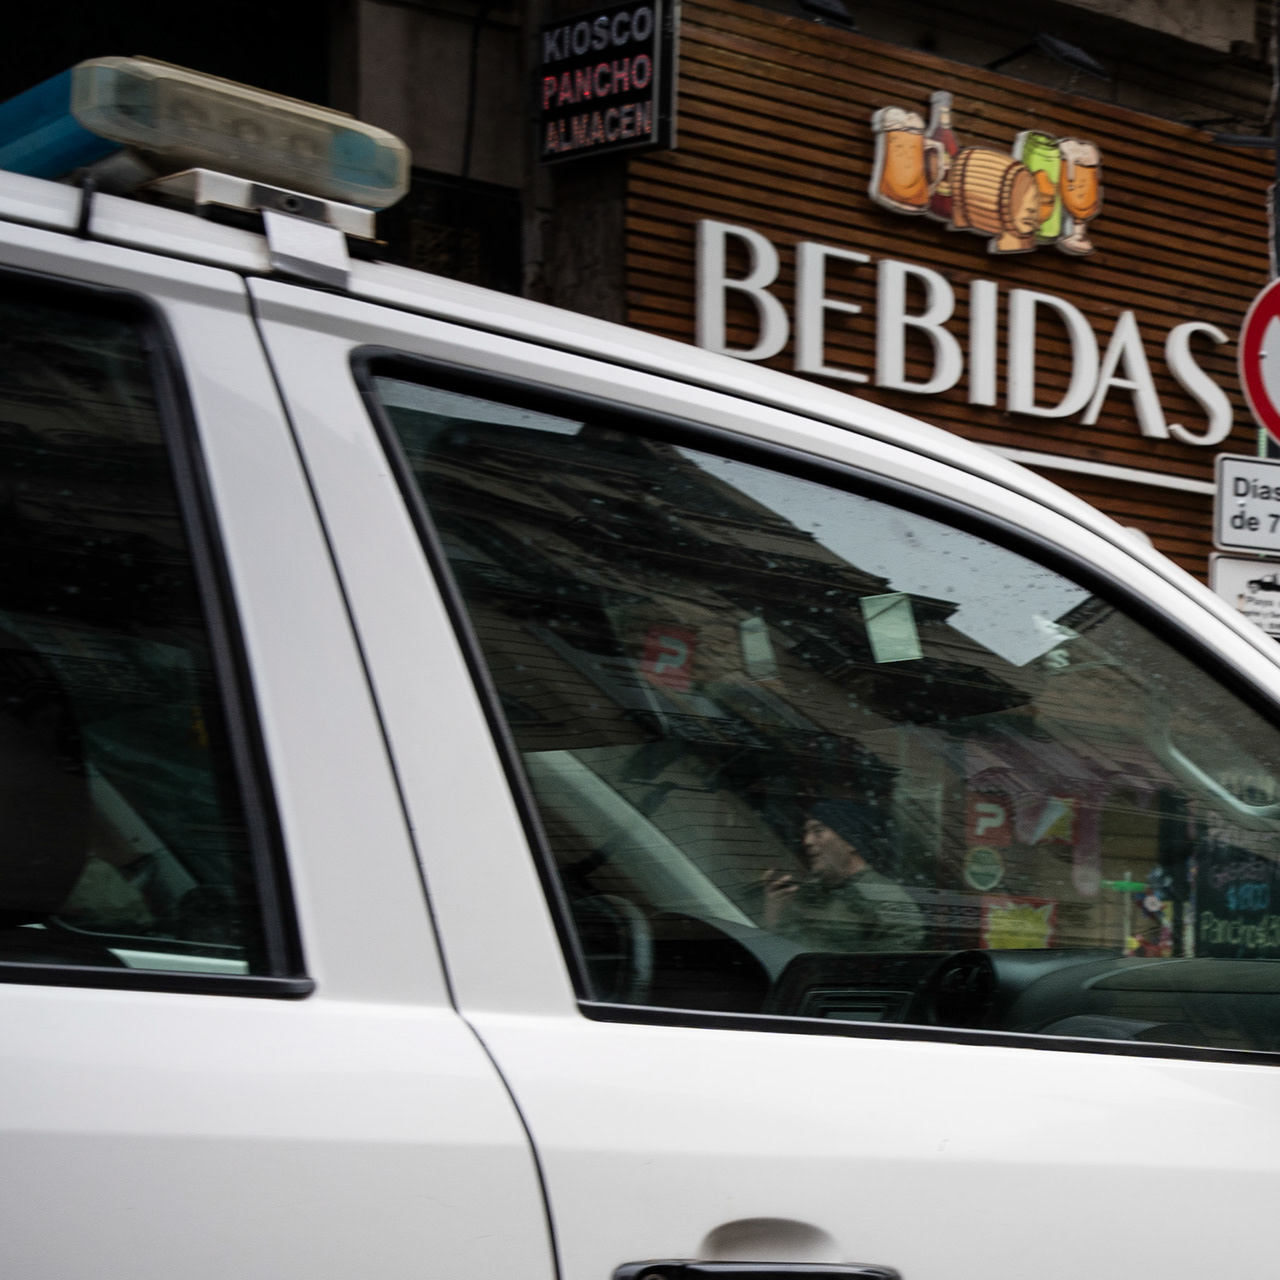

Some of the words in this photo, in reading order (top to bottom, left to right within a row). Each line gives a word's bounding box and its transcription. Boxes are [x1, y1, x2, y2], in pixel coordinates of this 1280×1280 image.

[542, 6, 653, 64] KIOSCO
[542, 53, 653, 110] PANCHO
[542, 102, 654, 155] ALMACEN
[695, 218, 1234, 447] BEBIDAS
[1230, 510, 1261, 533] de
[1268, 514, 1280, 534] 7
